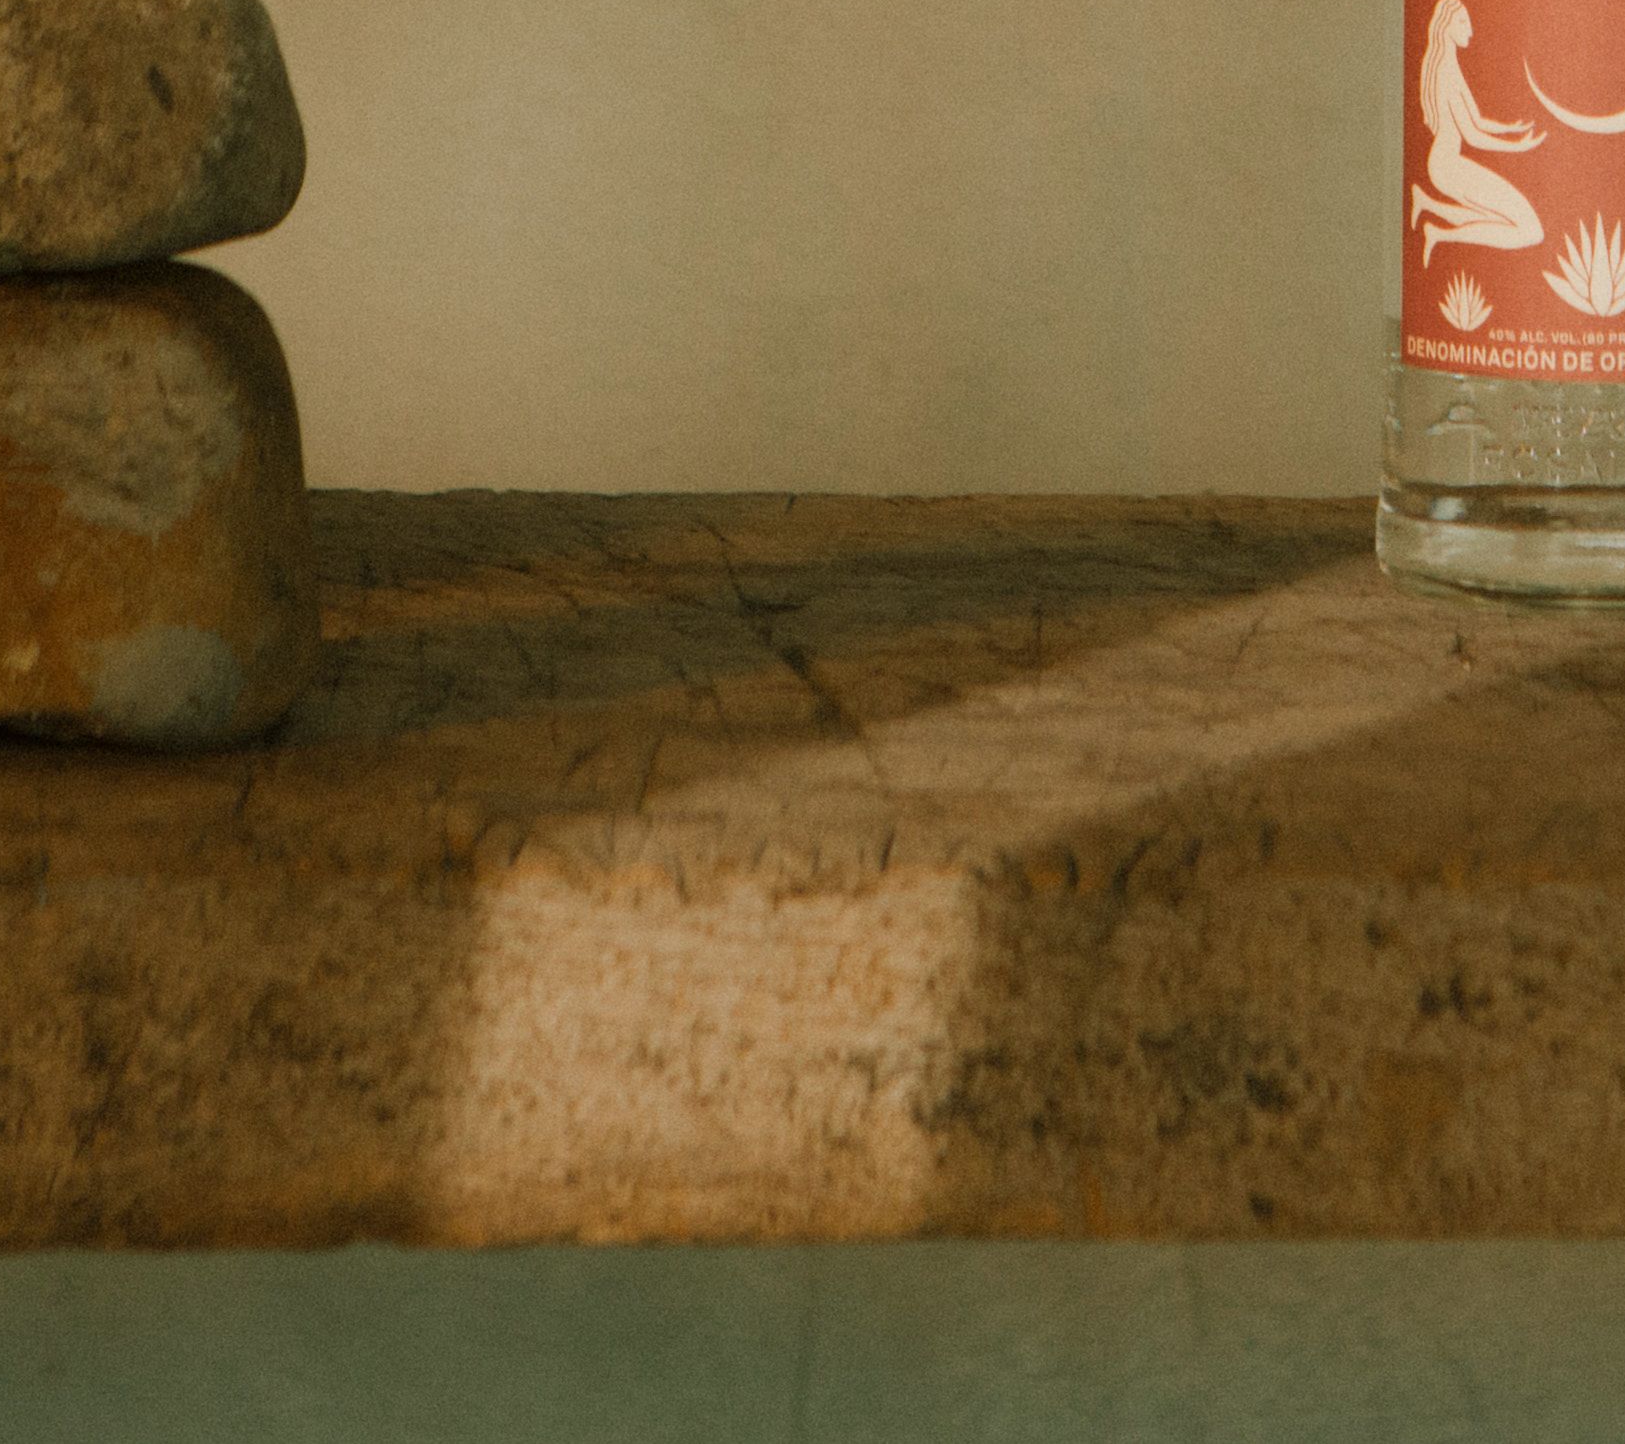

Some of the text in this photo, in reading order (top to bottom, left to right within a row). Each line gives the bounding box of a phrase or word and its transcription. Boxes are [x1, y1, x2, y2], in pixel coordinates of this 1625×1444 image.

[1489, 329, 1515, 342] 40%
[1520, 330, 1546, 344] ALC.
[1407, 336, 1556, 372] DENOMINACIÓN
[1563, 351, 1593, 373] DE
